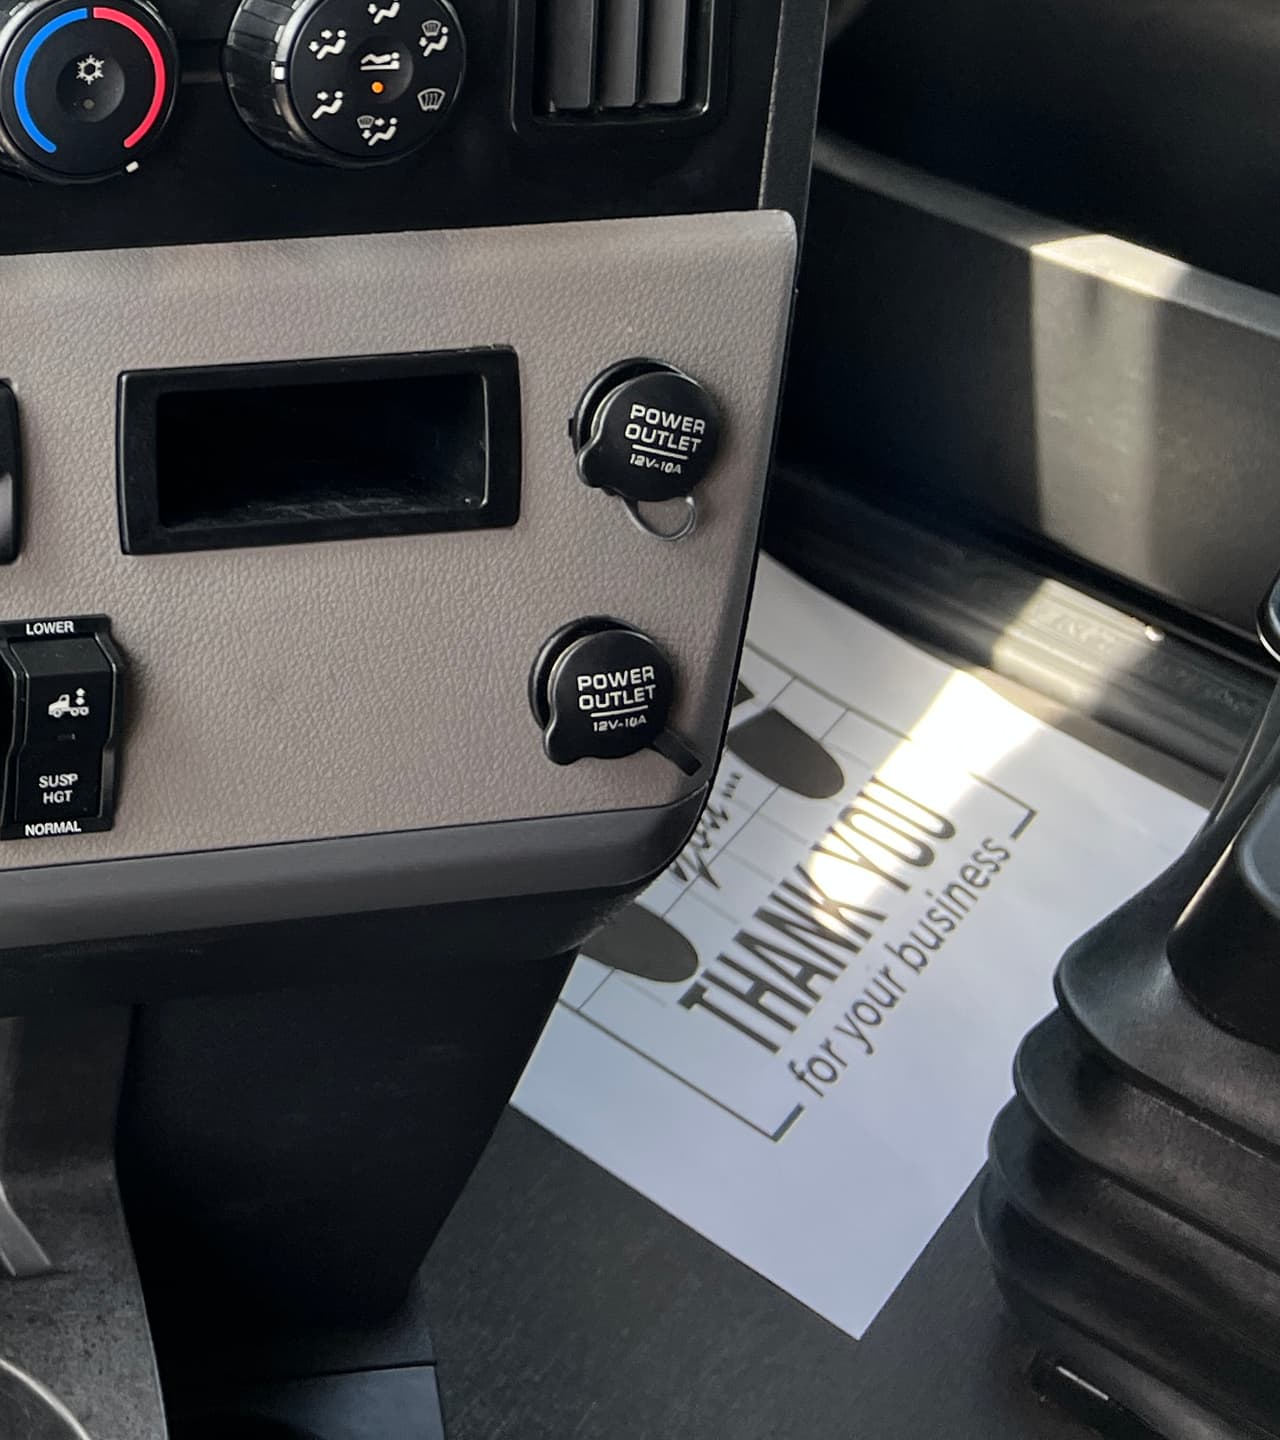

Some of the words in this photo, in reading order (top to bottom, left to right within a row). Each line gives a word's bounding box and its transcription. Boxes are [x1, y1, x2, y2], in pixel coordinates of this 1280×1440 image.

[630, 404, 706, 435] POWER
[625, 423, 702, 453] OUTLET
[629, 453, 682, 474] 12V-10A
[25, 620, 75, 635] LOWER
[577, 665, 655, 691] POWER
[578, 684, 656, 710] OUTLET
[593, 715, 647, 732] 12V-10A
[39, 773, 79, 790] SUSP
[42, 790, 73, 806] HGT
[24, 820, 81, 838] NORMAL
[679, 863, 887, 1054] THANK
[811, 776, 956, 893] YOU
[787, 1037, 851, 1098] for
[836, 966, 907, 1054] your
[892, 837, 1011, 975] business
